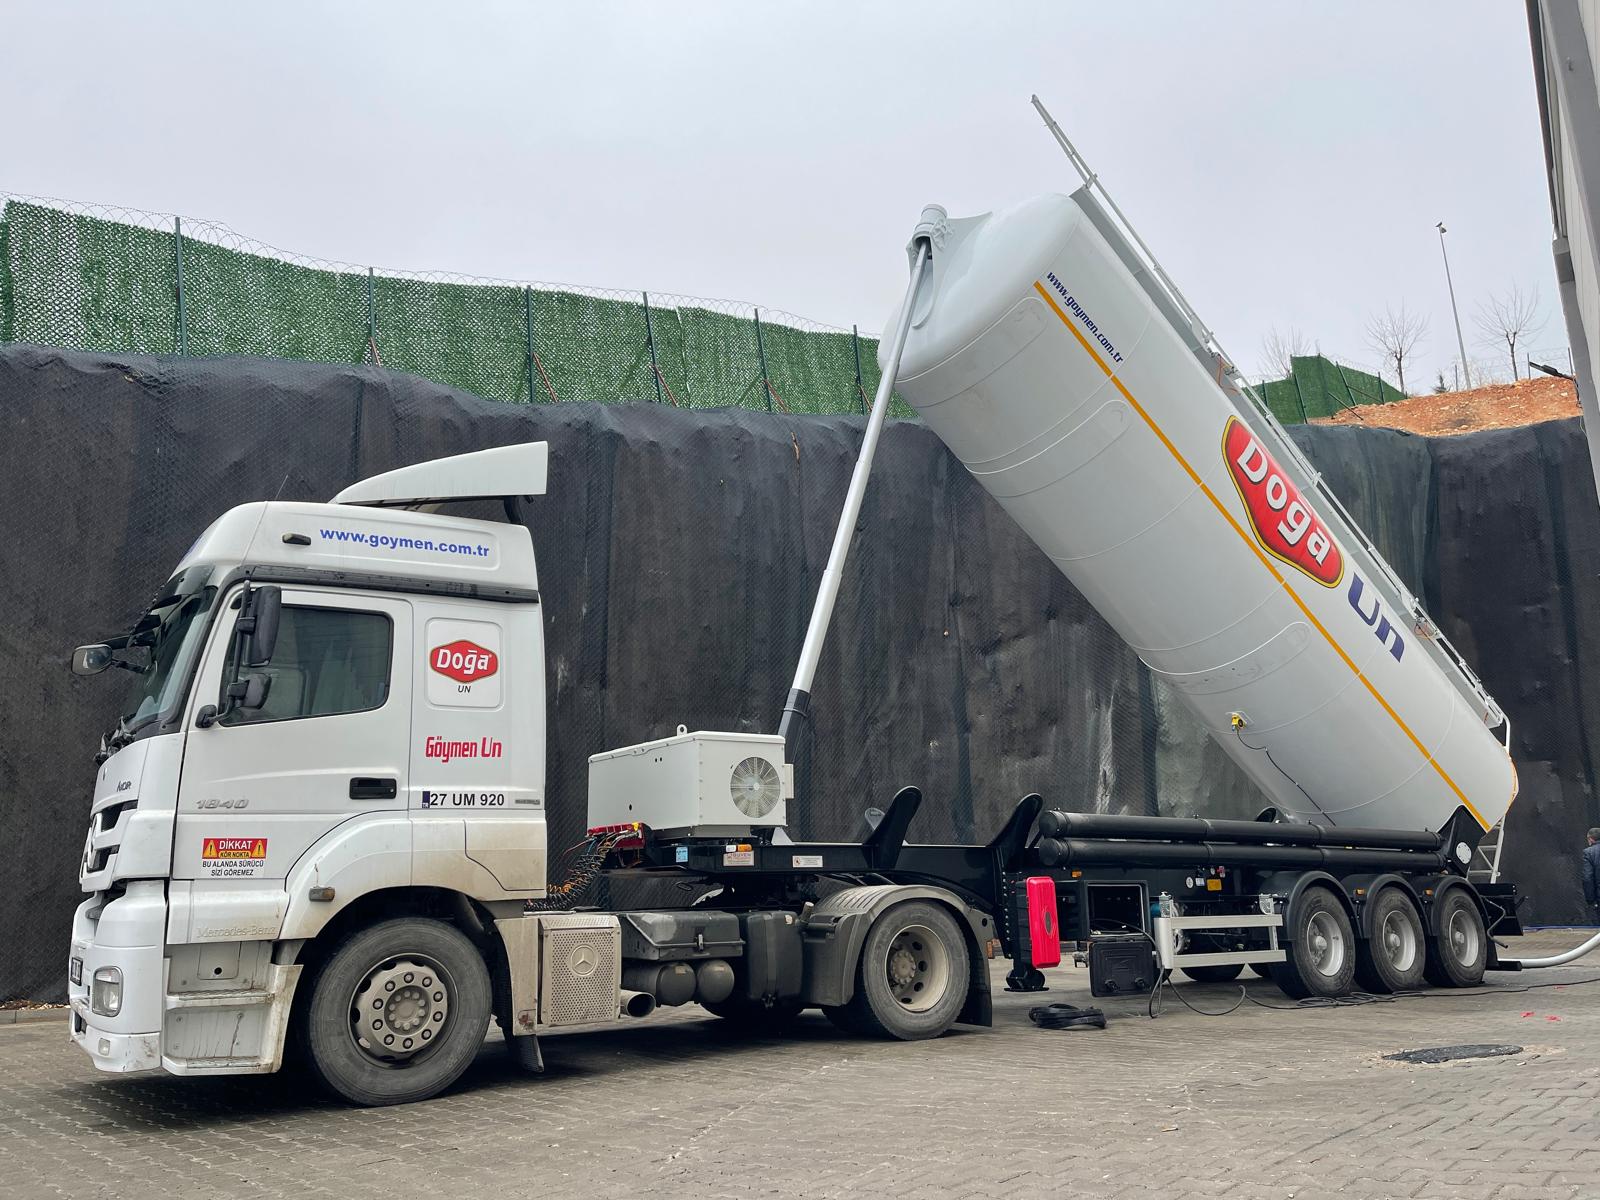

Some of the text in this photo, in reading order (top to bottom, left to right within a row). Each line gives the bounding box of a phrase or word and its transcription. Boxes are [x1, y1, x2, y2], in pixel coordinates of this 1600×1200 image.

[1046, 271, 1124, 363] www.goymen.com.tr
[319, 529, 490, 557] www.goymen.com.tr
[1347, 572, 1405, 663] Un
[457, 685, 472, 693] UN
[425, 736, 502, 763] Göymen Un
[196, 799, 249, 810] 1840
[430, 793, 448, 806] 27
[452, 793, 476, 806] UM
[480, 793, 505, 806] 920
[219, 838, 253, 850] DİKKAT
[196, 926, 277, 938] Mercedes-Benz
